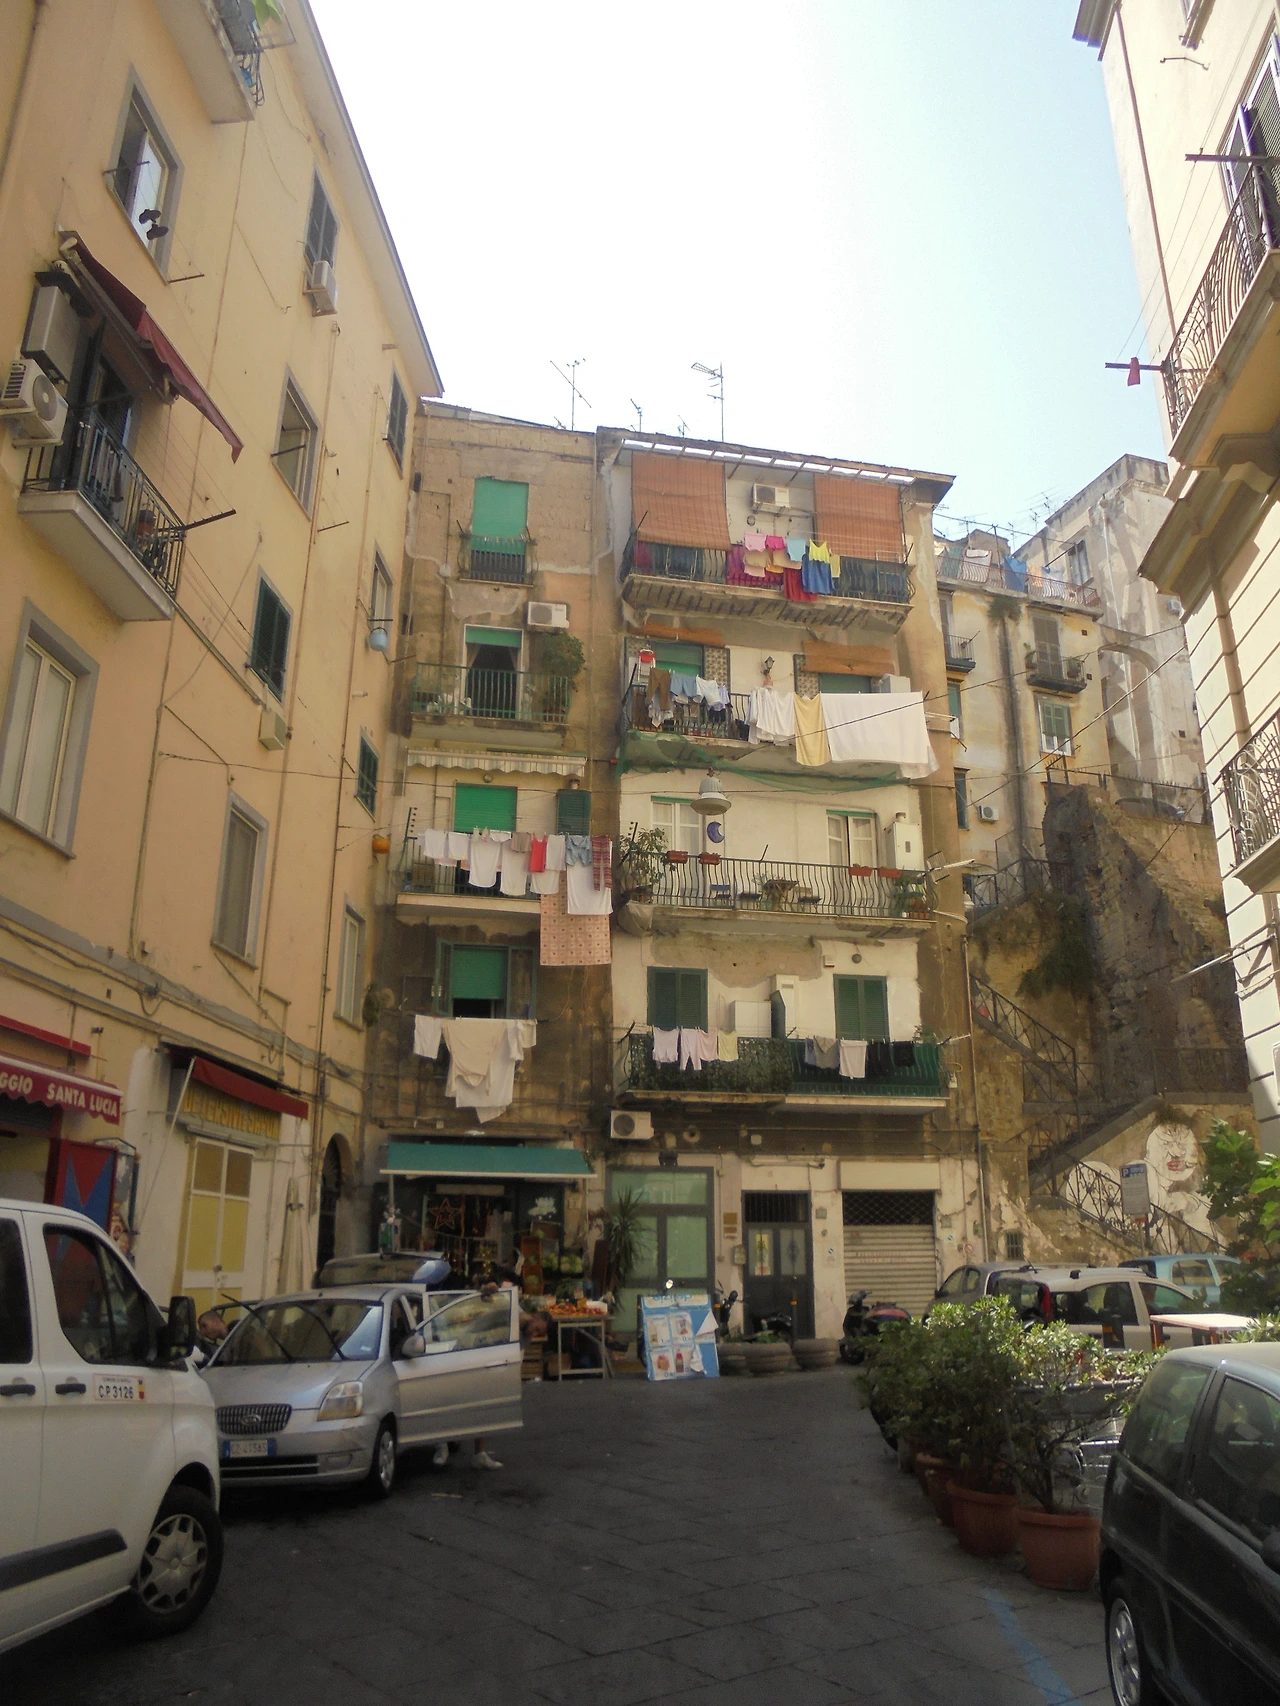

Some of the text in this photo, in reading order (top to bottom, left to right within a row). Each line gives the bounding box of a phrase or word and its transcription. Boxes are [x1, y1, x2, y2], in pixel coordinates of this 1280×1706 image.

[47, 1083, 86, 1109] SANTA
[89, 1094, 118, 1117] LUCIA
[1122, 1168, 1129, 1177] P
